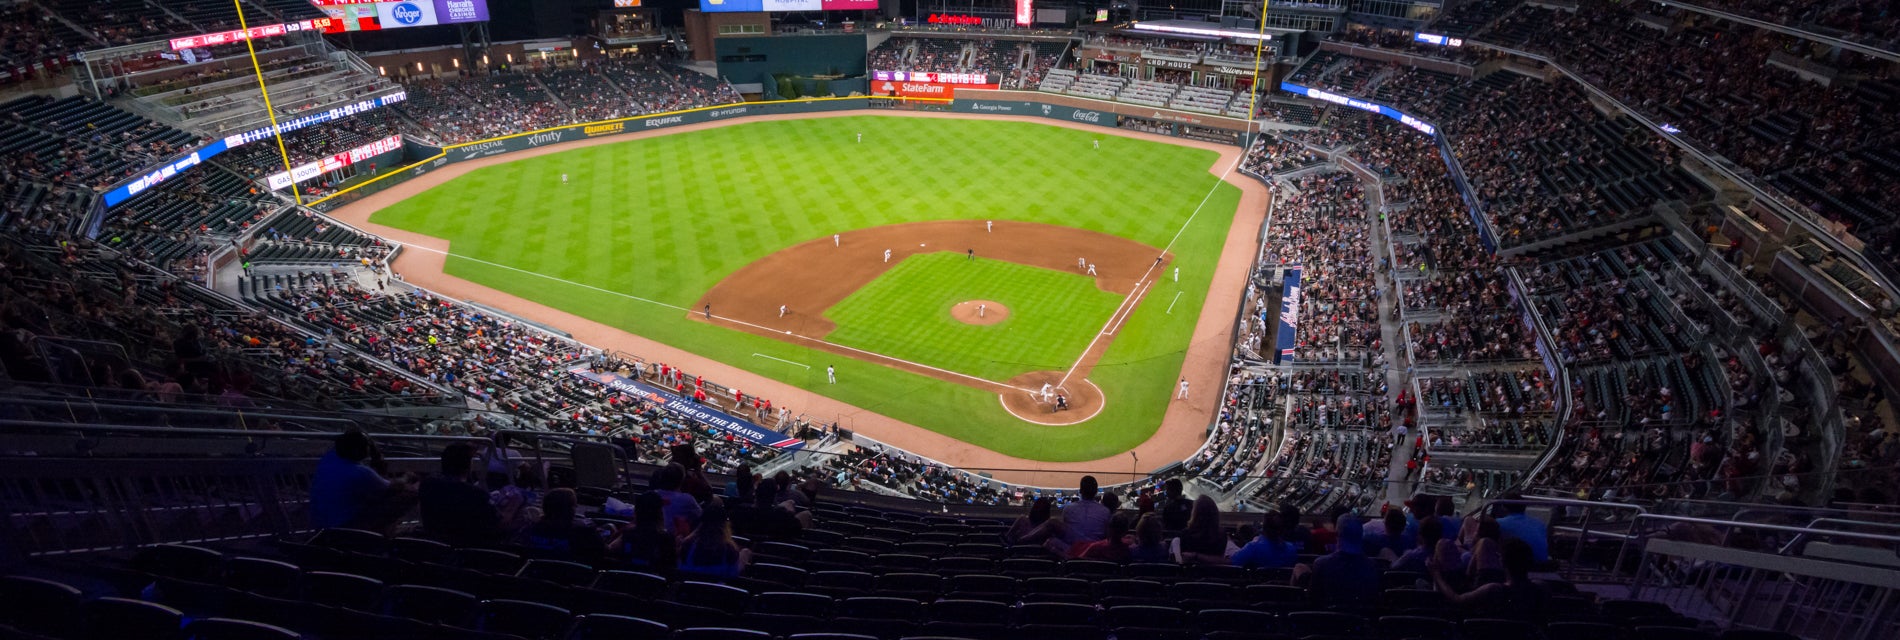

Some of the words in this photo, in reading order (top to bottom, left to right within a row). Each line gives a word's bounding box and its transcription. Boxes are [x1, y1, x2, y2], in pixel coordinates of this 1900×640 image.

[394, 5, 420, 23] Kroger
[902, 82, 944, 93] StateFarm
[720, 107, 747, 116] HYUNDAI
[584, 122, 625, 134] QUIKRETE
[645, 116, 683, 127] EQUIFAX
[528, 131, 562, 147] xfinity
[461, 140, 504, 153] WELLSTAR
[277, 176, 291, 185] GAS
[296, 167, 318, 179] SOUTH
[667, 400, 696, 416] HOME
[698, 411, 710, 420] OF
[710, 415, 729, 427] THE
[726, 421, 765, 440] BRAVES
